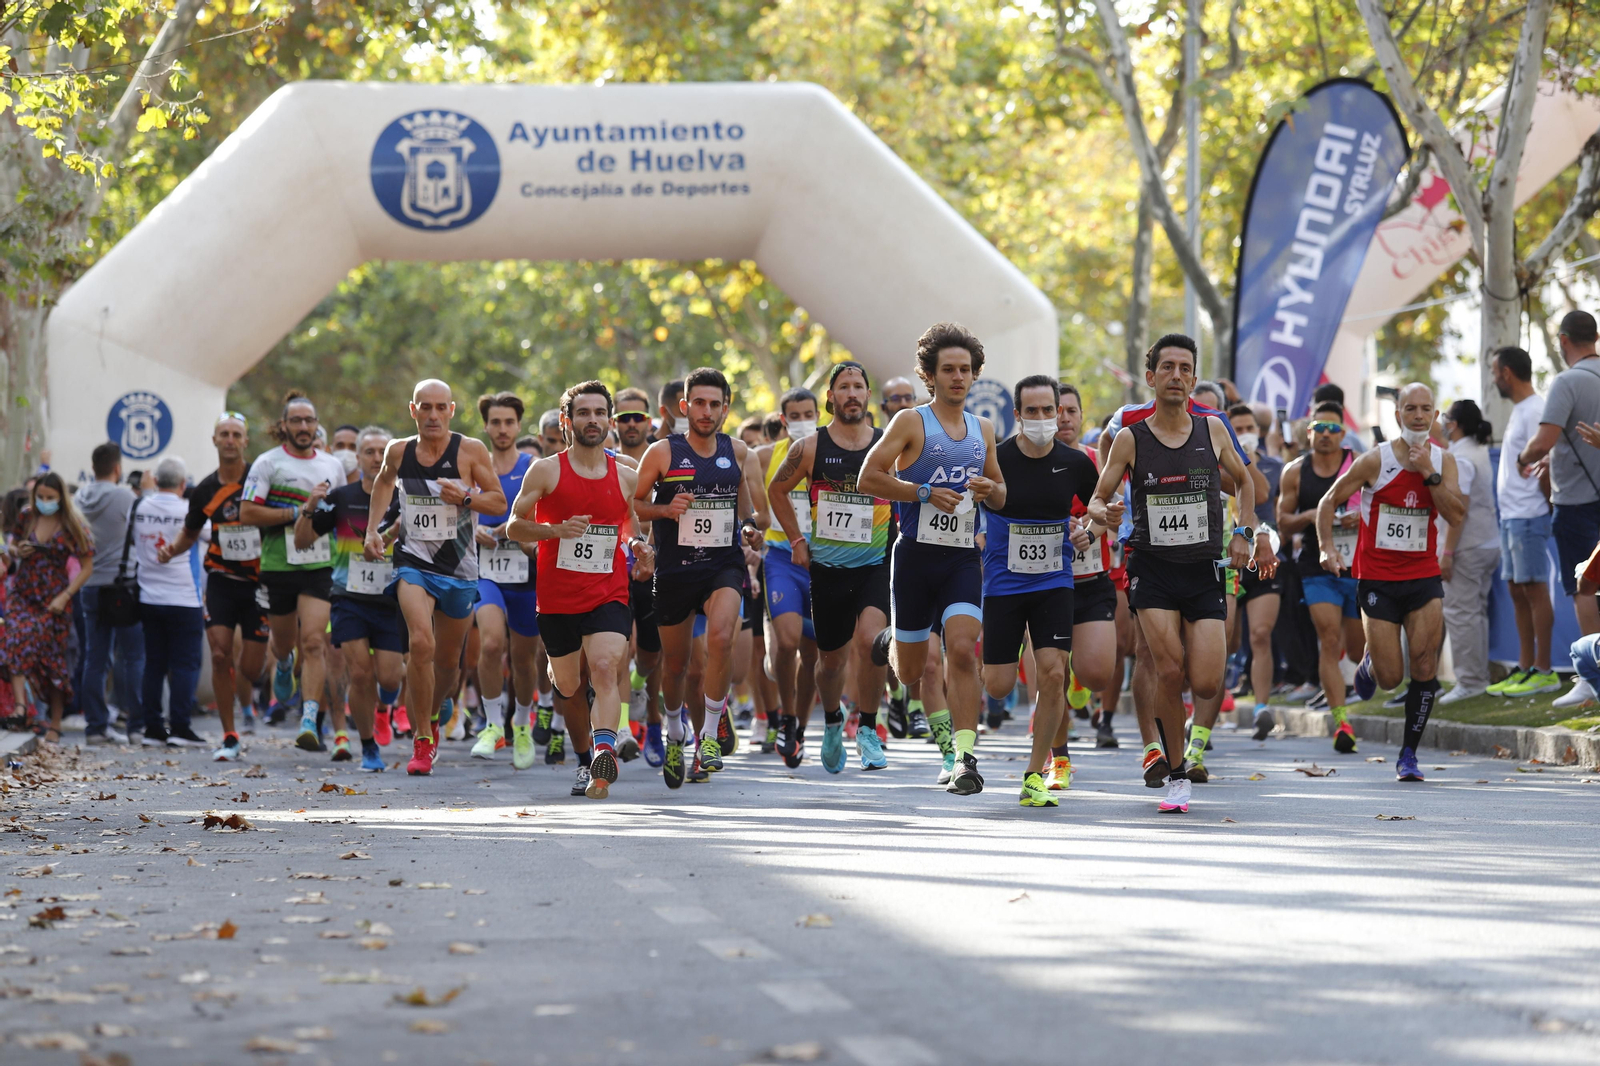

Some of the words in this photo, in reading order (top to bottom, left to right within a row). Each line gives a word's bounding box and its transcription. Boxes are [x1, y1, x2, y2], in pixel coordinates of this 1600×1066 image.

[508, 121, 746, 149] Ayuntamiento
[577, 149, 616, 173] de
[630, 148, 746, 173] Huelva
[1342, 130, 1383, 218] SYRLUZ
[631, 182, 654, 197] de
[661, 182, 751, 199] Deportes
[1269, 121, 1358, 348] HYUNDAI
[691, 501, 709, 509] VUELTA
[710, 501, 715, 509] A
[715, 501, 731, 509] HUELVA
[829, 494, 847, 503] VUELTA
[852, 495, 870, 505] HUELVA
[1158, 496, 1179, 505] VUELTA
[1179, 496, 1184, 504] A
[1184, 494, 1204, 503] HUELVA
[135, 513, 185, 527] STAFF
[413, 513, 437, 529] 401
[694, 518, 712, 534] 59
[826, 510, 853, 529] 177
[929, 513, 958, 533] 490
[1158, 513, 1189, 532] 444
[1021, 526, 1040, 534] VUELTA
[1040, 526, 1045, 534] A
[1045, 525, 1062, 534] HUELVA
[1386, 522, 1412, 540] 561
[226, 538, 247, 552] 453
[574, 542, 593, 560] 85
[1019, 543, 1047, 561] 633
[488, 557, 511, 572] 117
[361, 569, 375, 584] 14
[1411, 691, 1433, 732] Kalenji
